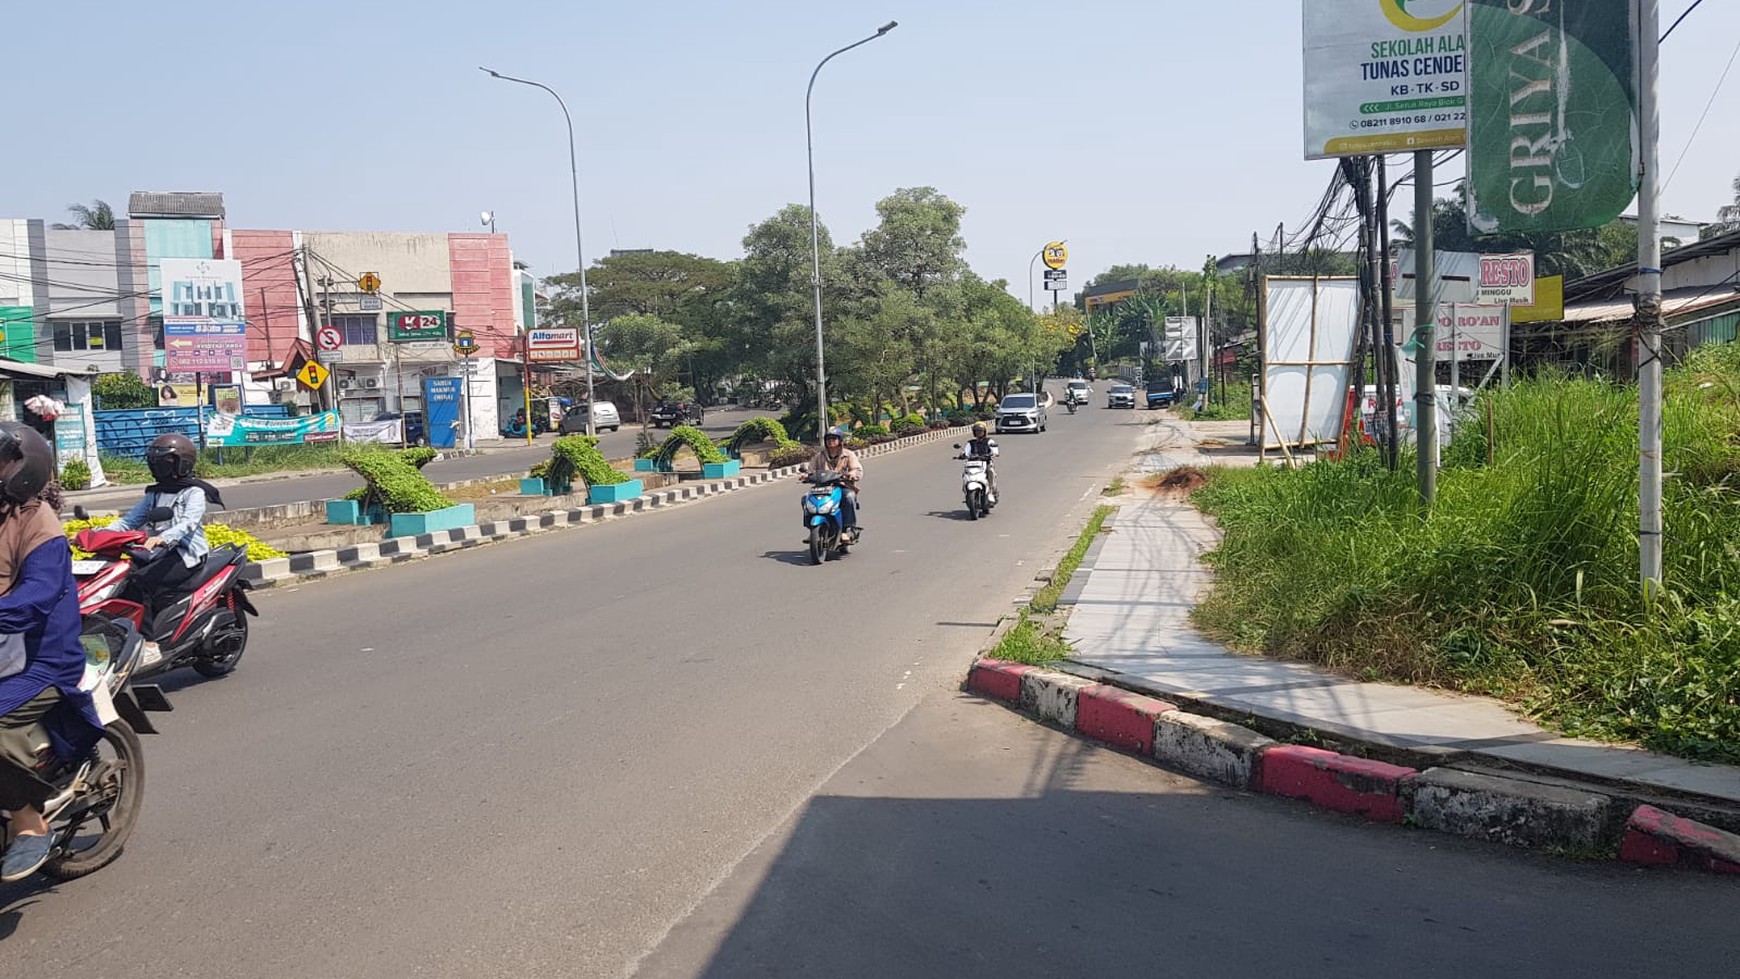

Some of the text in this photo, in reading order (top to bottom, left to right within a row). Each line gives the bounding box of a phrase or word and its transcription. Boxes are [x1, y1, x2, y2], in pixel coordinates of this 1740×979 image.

[1371, 37, 1434, 59] SEKOLAH
[1360, 54, 1466, 81] TUNAS CENDE
[1391, 80, 1460, 96] KB TK SD
[1438, 97, 1455, 107] Blok
[1360, 119, 1387, 128] 08211
[1390, 116, 1412, 126] 8910
[1414, 114, 1427, 124] 68
[1434, 112, 1451, 123] 021
[1509, 29, 1553, 216] GRIYA
[1480, 258, 1529, 288] RESTO
[422, 317, 437, 327] 24
[532, 331, 574, 341] Alfamart
